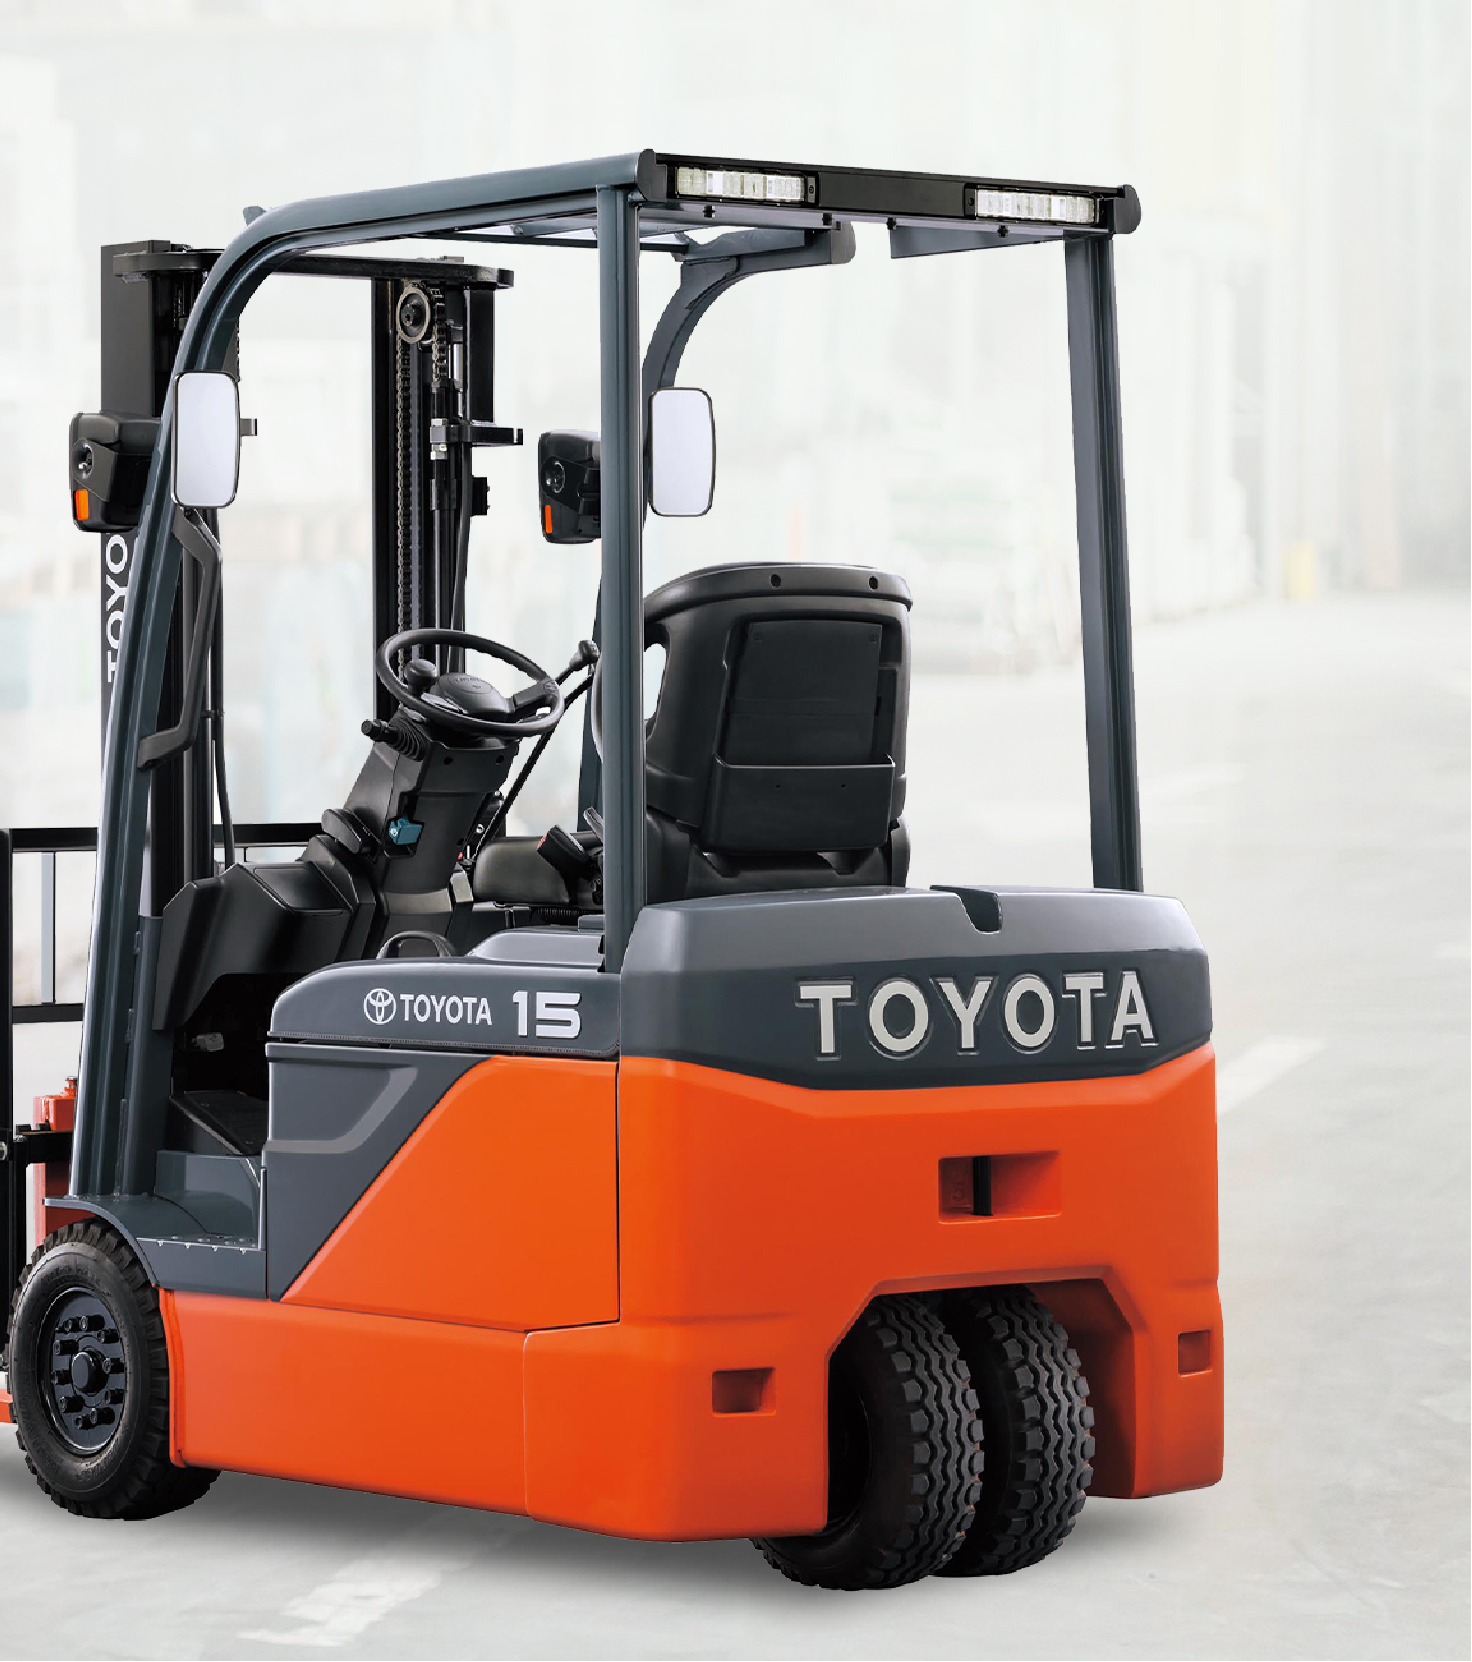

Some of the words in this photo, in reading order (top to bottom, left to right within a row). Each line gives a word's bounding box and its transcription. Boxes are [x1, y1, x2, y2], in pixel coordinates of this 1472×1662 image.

[400, 993, 493, 1026] TOYOTA
[513, 990, 582, 1039] 15
[797, 969, 1156, 1057] TOYOTA
